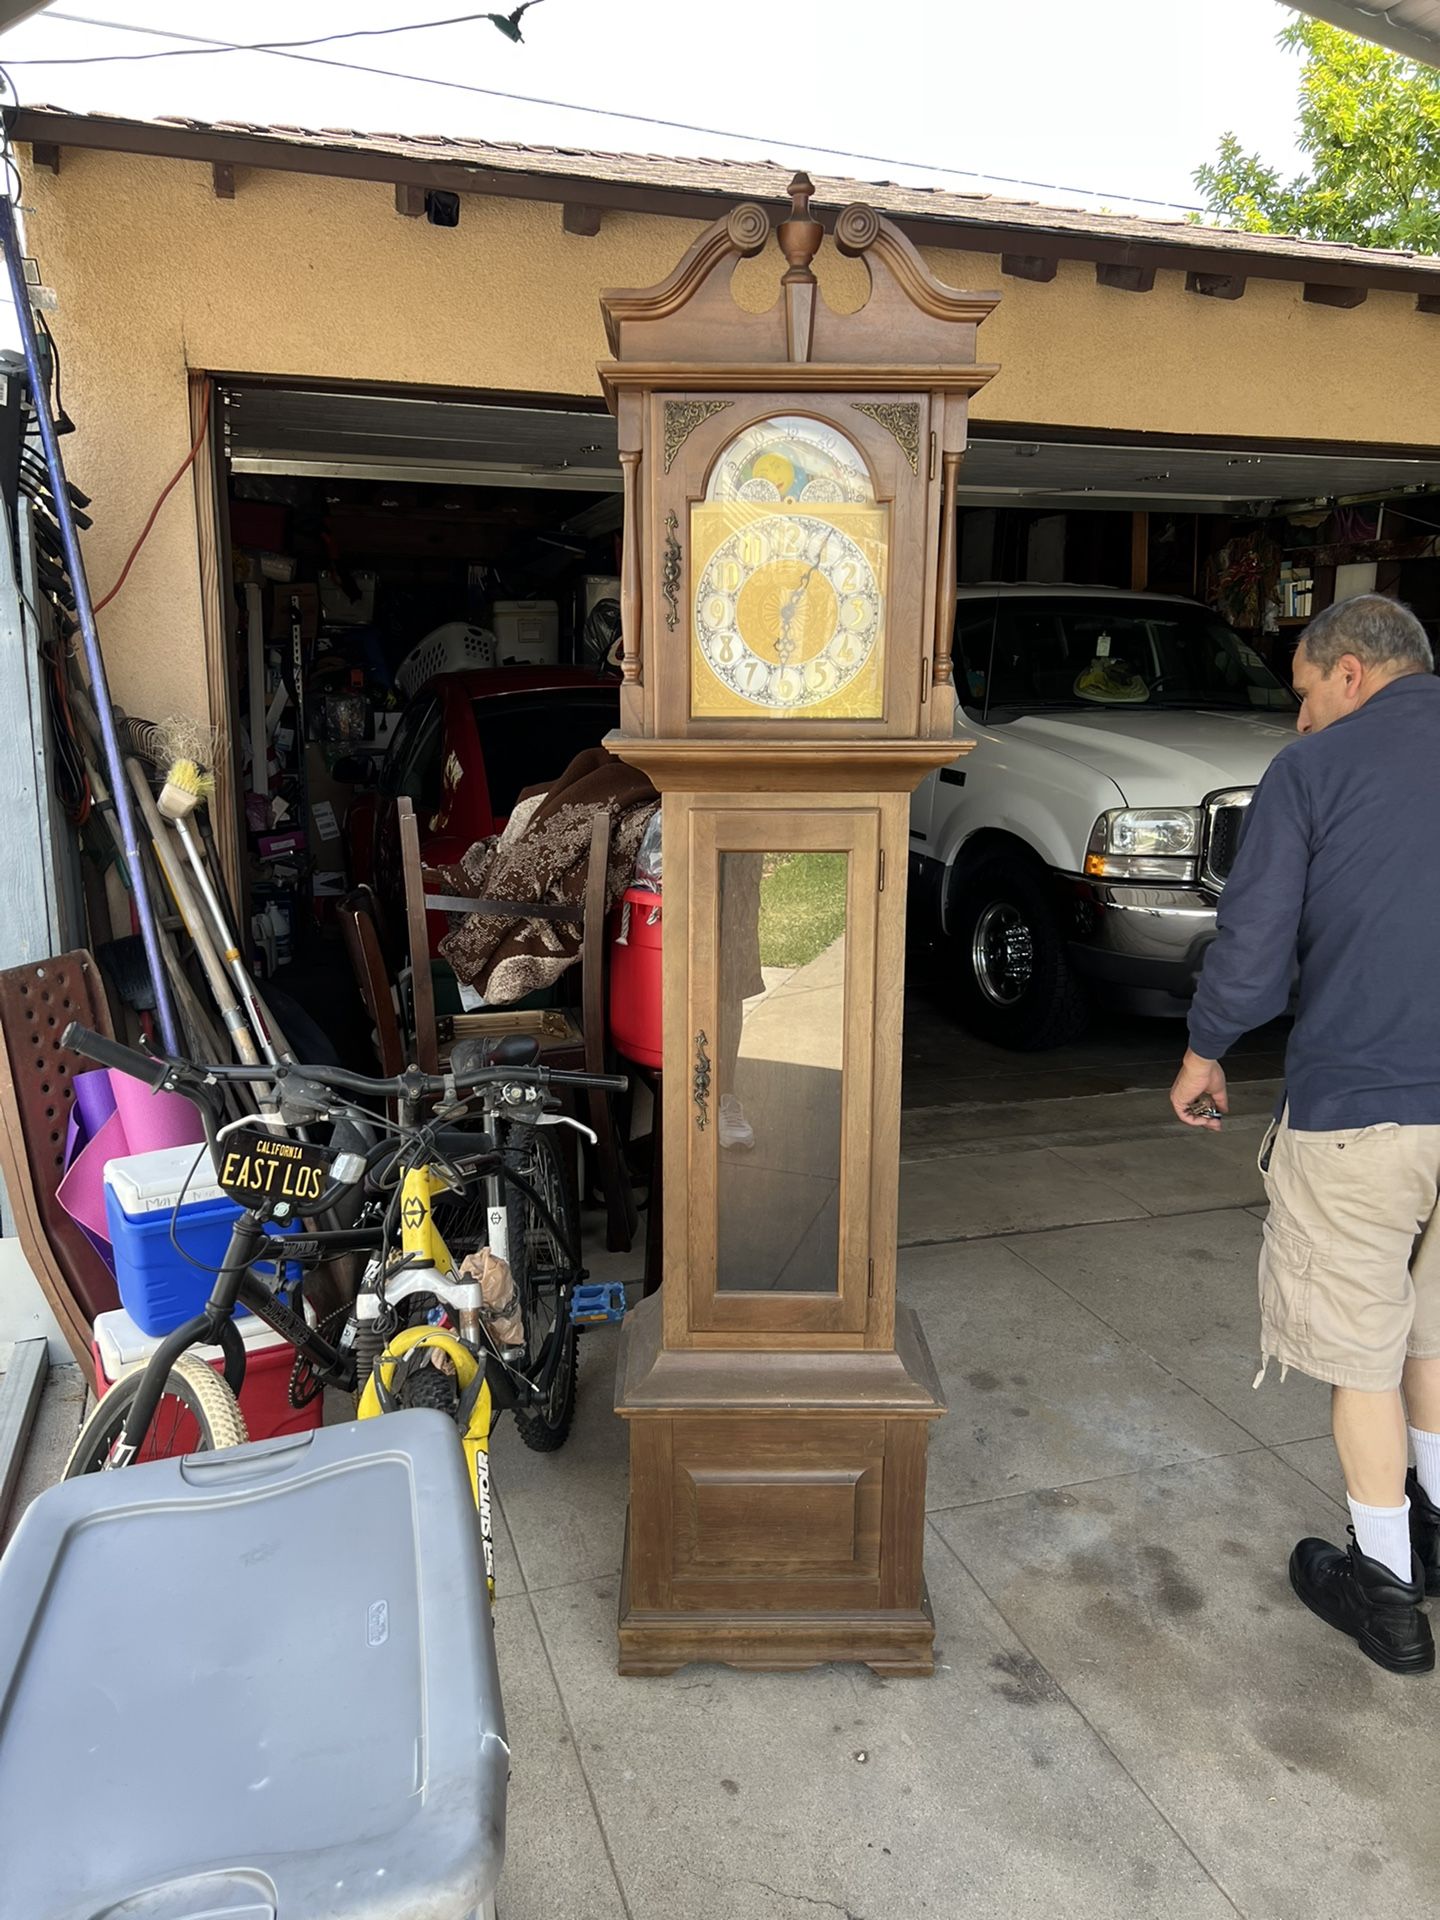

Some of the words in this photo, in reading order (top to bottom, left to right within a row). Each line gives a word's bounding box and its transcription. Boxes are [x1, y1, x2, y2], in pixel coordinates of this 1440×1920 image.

[743, 534, 762, 566] 11
[775, 522, 801, 555] 12
[716, 562, 739, 591] 10
[841, 561, 858, 591] 2
[710, 599, 725, 627] 9
[851, 597, 864, 626] 3
[719, 635, 734, 662] 8
[837, 634, 854, 660] 4
[744, 661, 758, 687] 7
[778, 670, 793, 698] 6
[814, 660, 828, 689] 5
[256, 1139, 303, 1160] CALIFORNIA
[221, 1152, 280, 1193] EAST
[281, 1163, 323, 1199] LOS
[476, 1449, 493, 1539] SUNTOUR
[482, 1540, 495, 1578] SR
